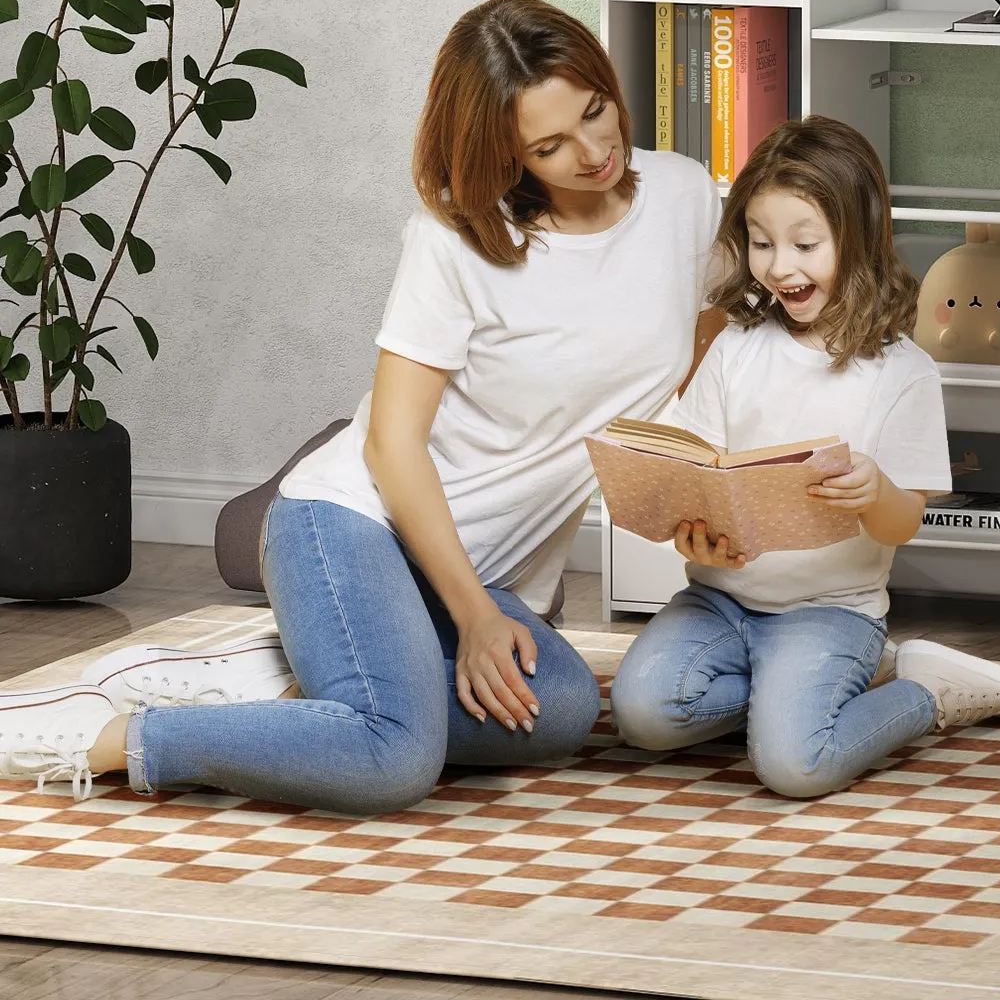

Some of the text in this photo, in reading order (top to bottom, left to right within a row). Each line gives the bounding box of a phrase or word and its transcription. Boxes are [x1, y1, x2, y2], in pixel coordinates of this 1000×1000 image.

[658, 6, 668, 49] Over
[713, 15, 733, 69] 1000
[739, 17, 747, 73] TEXTILE DESIGNERS
[659, 63, 668, 94] the
[703, 51, 711, 104] EERO SAARINEN
[921, 513, 973, 528] WATER
